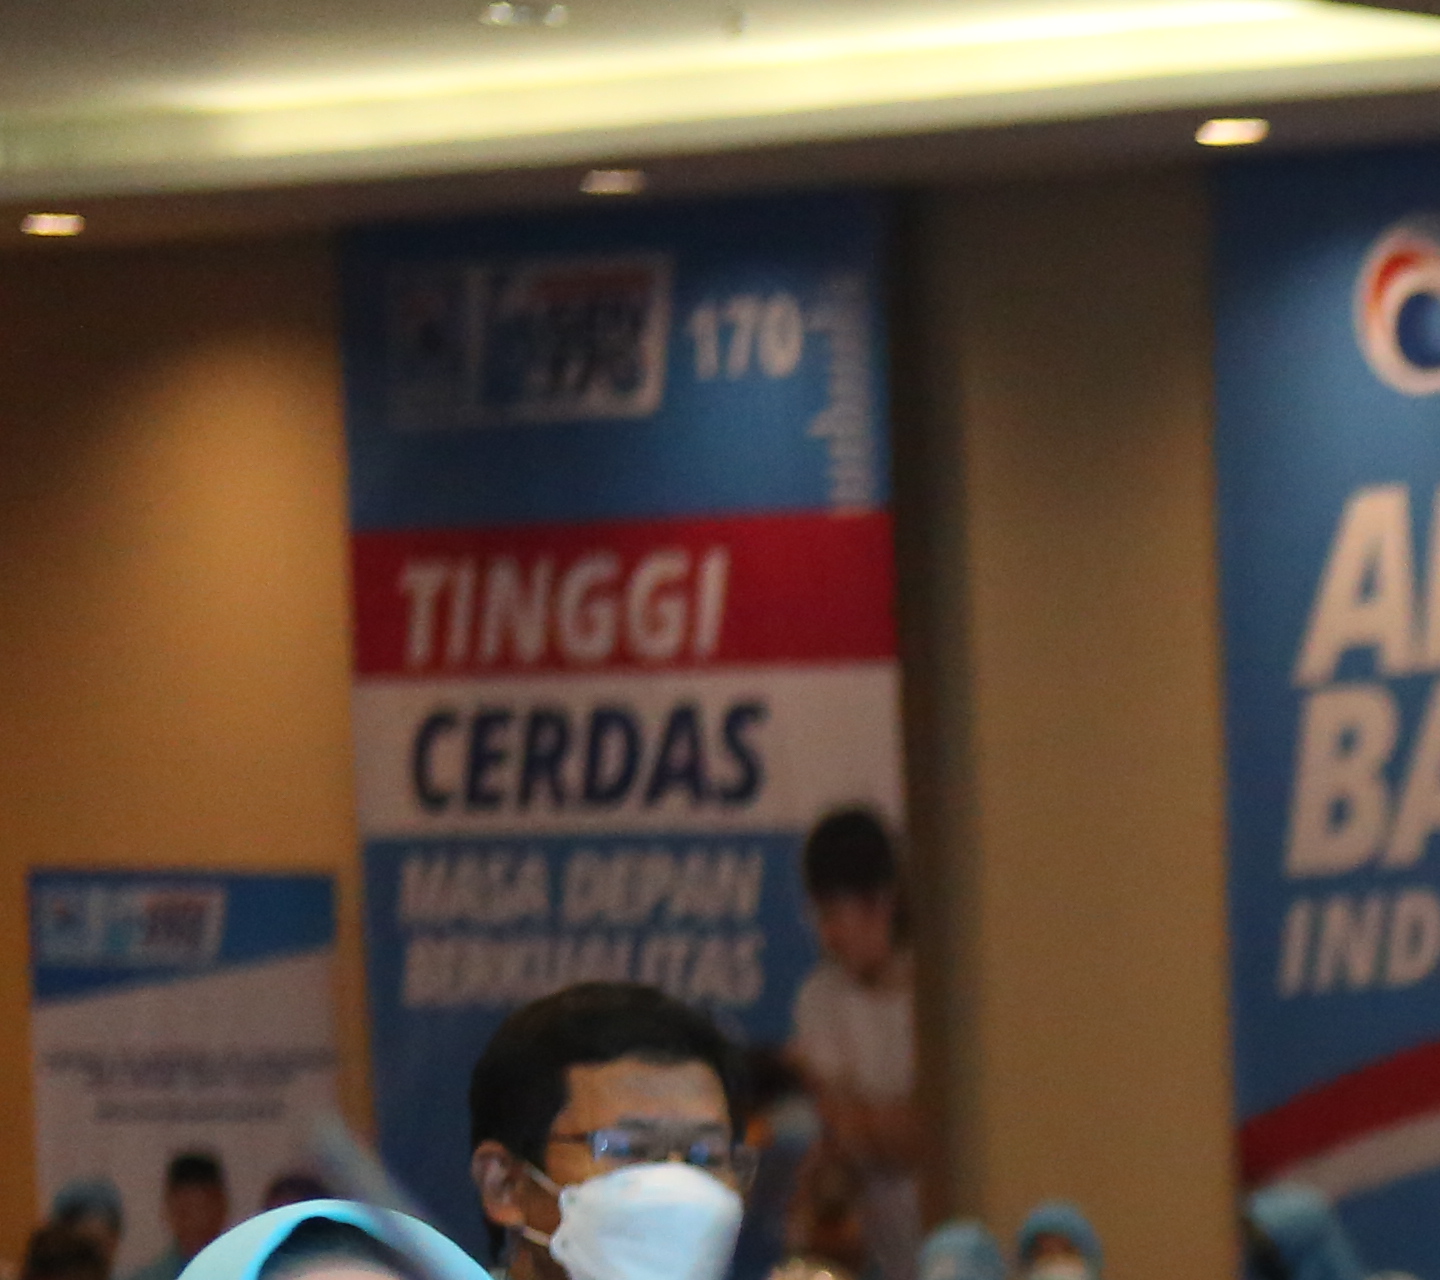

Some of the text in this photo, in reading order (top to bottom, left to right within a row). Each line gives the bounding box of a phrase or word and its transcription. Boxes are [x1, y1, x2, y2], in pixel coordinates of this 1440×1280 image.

[688, 293, 802, 381] 170
[399, 545, 730, 667] TINGGI
[413, 695, 768, 813] CERDAS
